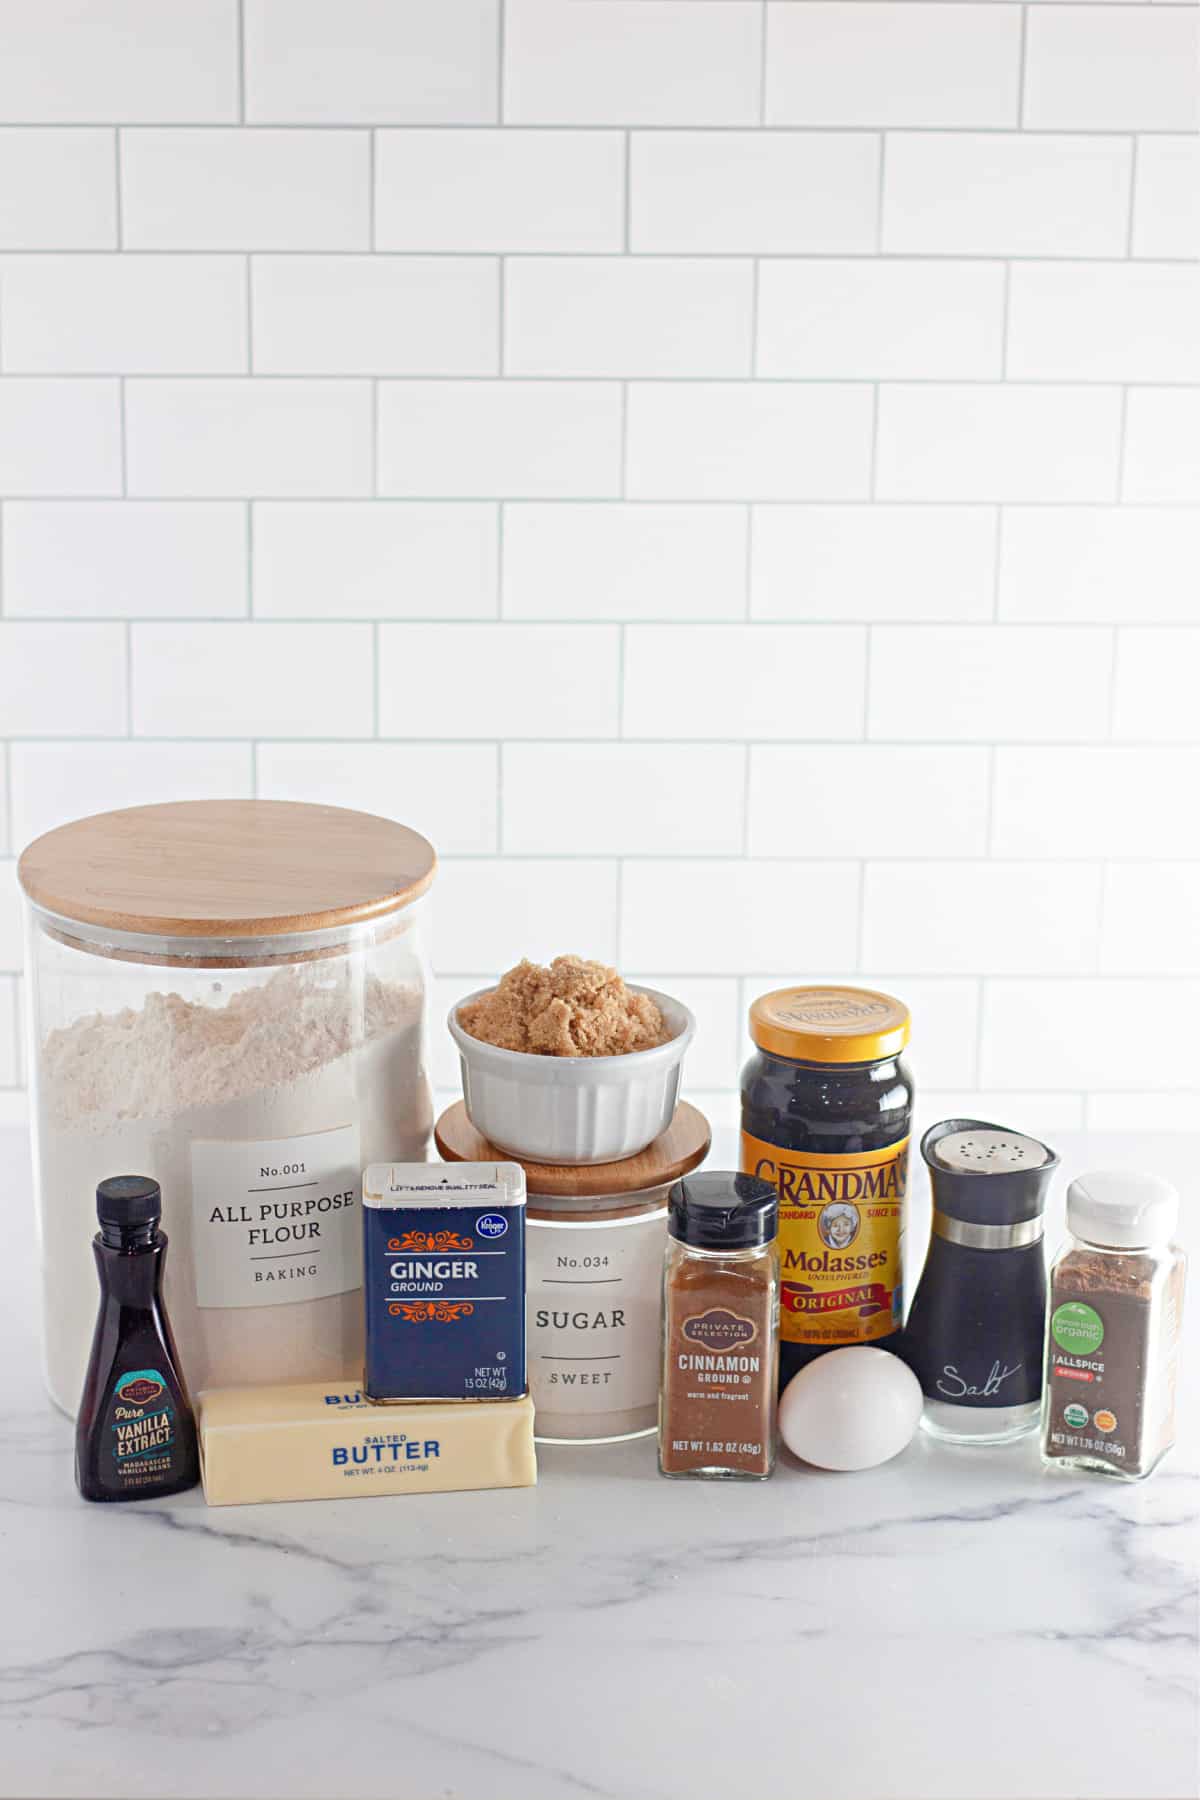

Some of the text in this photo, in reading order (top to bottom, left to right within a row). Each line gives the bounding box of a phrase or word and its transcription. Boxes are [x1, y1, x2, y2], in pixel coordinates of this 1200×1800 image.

[260, 1163, 306, 1177] No.001
[209, 1191, 354, 1223] ALL PURPOSE
[777, 1211, 816, 1220] TANDARD
[248, 1222, 321, 1245] FLOUR
[557, 1256, 609, 1268] No.034
[784, 1250, 887, 1272] Molasses
[255, 1265, 318, 1282] BAKING
[390, 1262, 479, 1279] GINGER
[390, 1282, 444, 1292] GROUND
[793, 1287, 874, 1311] ORIGINAL
[536, 1310, 626, 1329] SUGAR
[694, 1323, 744, 1331] PRIVATE
[474, 1367, 507, 1377] NET WT
[679, 1354, 760, 1373] CINNAMON
[1056, 1356, 1105, 1373] ALLSPICE
[475, 1378, 487, 1389] OZ
[550, 1372, 612, 1385] SWEET
[697, 1373, 740, 1384] GROUND
[936, 1360, 1022, 1396] Salt
[115, 1407, 144, 1419] Pure
[117, 1413, 169, 1440] VANILLA
[118, 1427, 170, 1456] EXTRACT
[364, 1434, 407, 1444] SALTED
[672, 1440, 689, 1451] NET
[690, 1440, 704, 1452] WT
[725, 1441, 737, 1454] OZ
[332, 1440, 440, 1465] BUTTER
